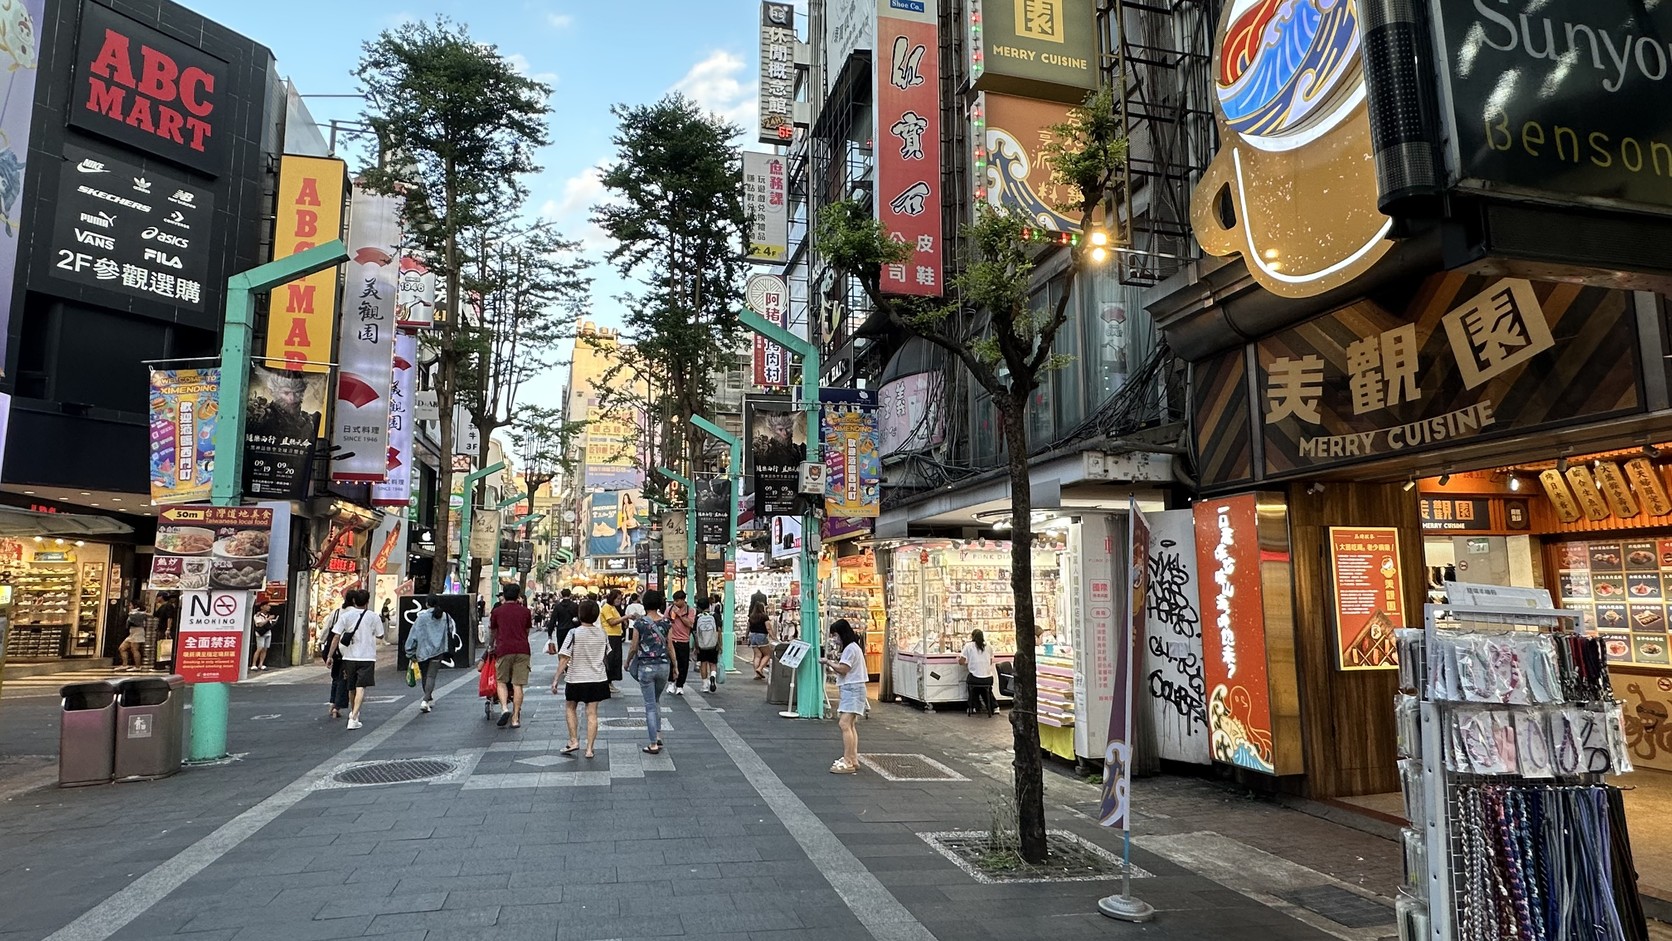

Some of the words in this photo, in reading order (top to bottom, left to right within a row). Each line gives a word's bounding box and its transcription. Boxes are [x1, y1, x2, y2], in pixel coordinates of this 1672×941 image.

[992, 44, 1036, 61] MERRY
[1041, 53, 1087, 70] CUISINE
[90, 28, 215, 117] ABC
[85, 77, 212, 153] MART
[82, 158, 105, 170] NIKE
[77, 185, 152, 213] SKECHERS
[75, 228, 116, 250] VANS
[157, 231, 189, 249] asics
[144, 248, 183, 270] FILA
[915, 233, 936, 286] 皮鞋
[57, 249, 201, 304] 2F參觀選購
[400, 282, 425, 292] 1946
[358, 278, 385, 344] 美觀園
[1265, 277, 1556, 425] 美觀園
[160, 384, 217, 394] XIMENDING
[343, 435, 361, 443] SINCE
[362, 435, 378, 443] 1946
[344, 425, 379, 435] 日式料理
[1299, 431, 1378, 457] MERRY
[1387, 400, 1496, 450] CUISINE
[205, 508, 272, 519] 台灣道地美食
[184, 636, 237, 649] 全面禁菸
